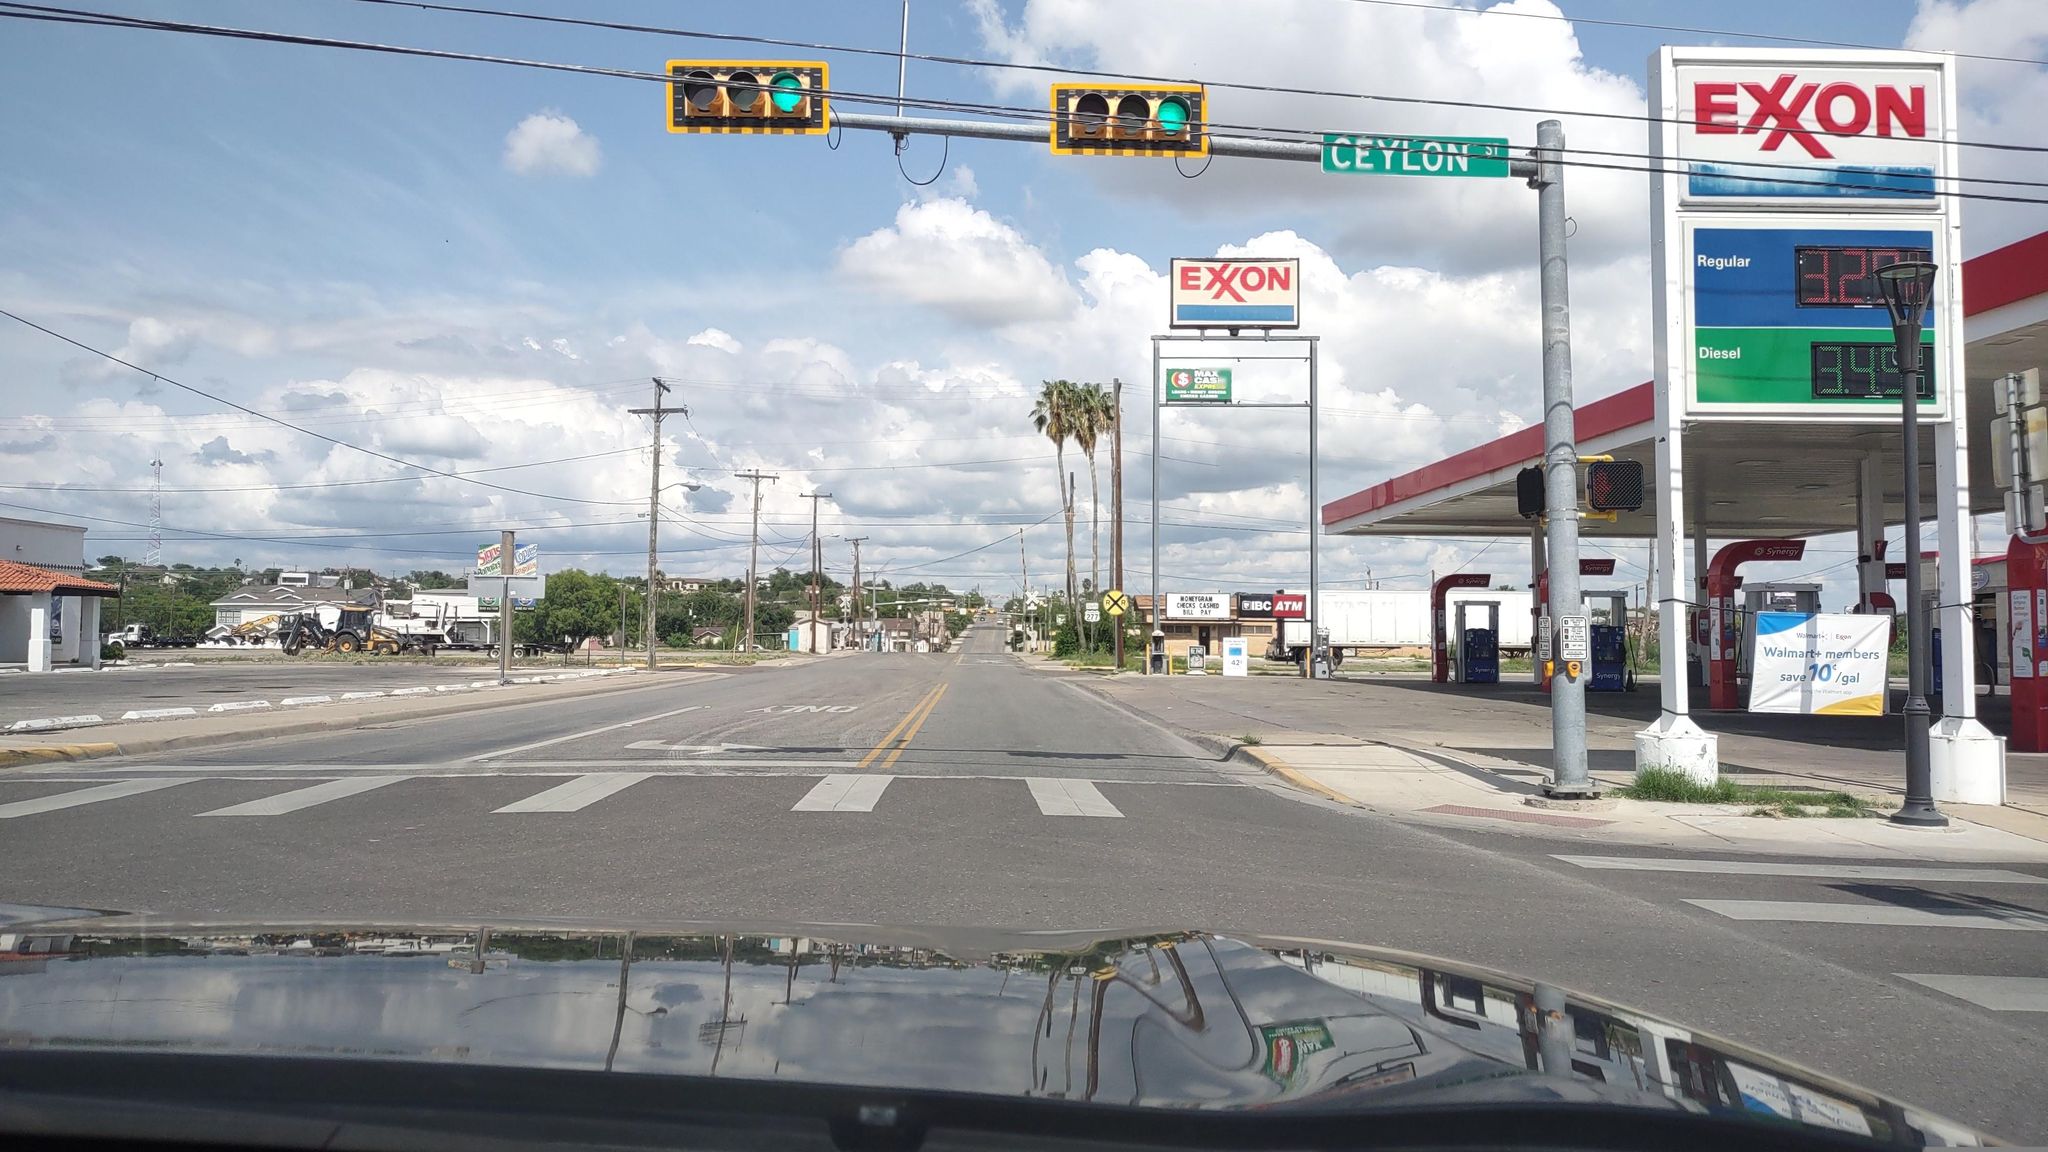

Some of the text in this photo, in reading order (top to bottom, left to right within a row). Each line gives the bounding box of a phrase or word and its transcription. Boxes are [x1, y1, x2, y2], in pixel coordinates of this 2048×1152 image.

[1693, 74, 1926, 159] EXXON
[1331, 136, 1468, 172] CEYLON
[1697, 254, 1751, 270] Regular
[1180, 263, 1290, 303] EXXON
[1699, 346, 1741, 359] Diesel
[478, 546, 501, 566] Signs
[1766, 548, 1799, 557] Synergy
[1252, 600, 1303, 611] IBC ATM
[1763, 646, 1880, 660] Walmart+ members
[1475, 667, 1496, 675] Synergy
[1596, 672, 1621, 680] Synergy
[1780, 672, 1807, 682] save
